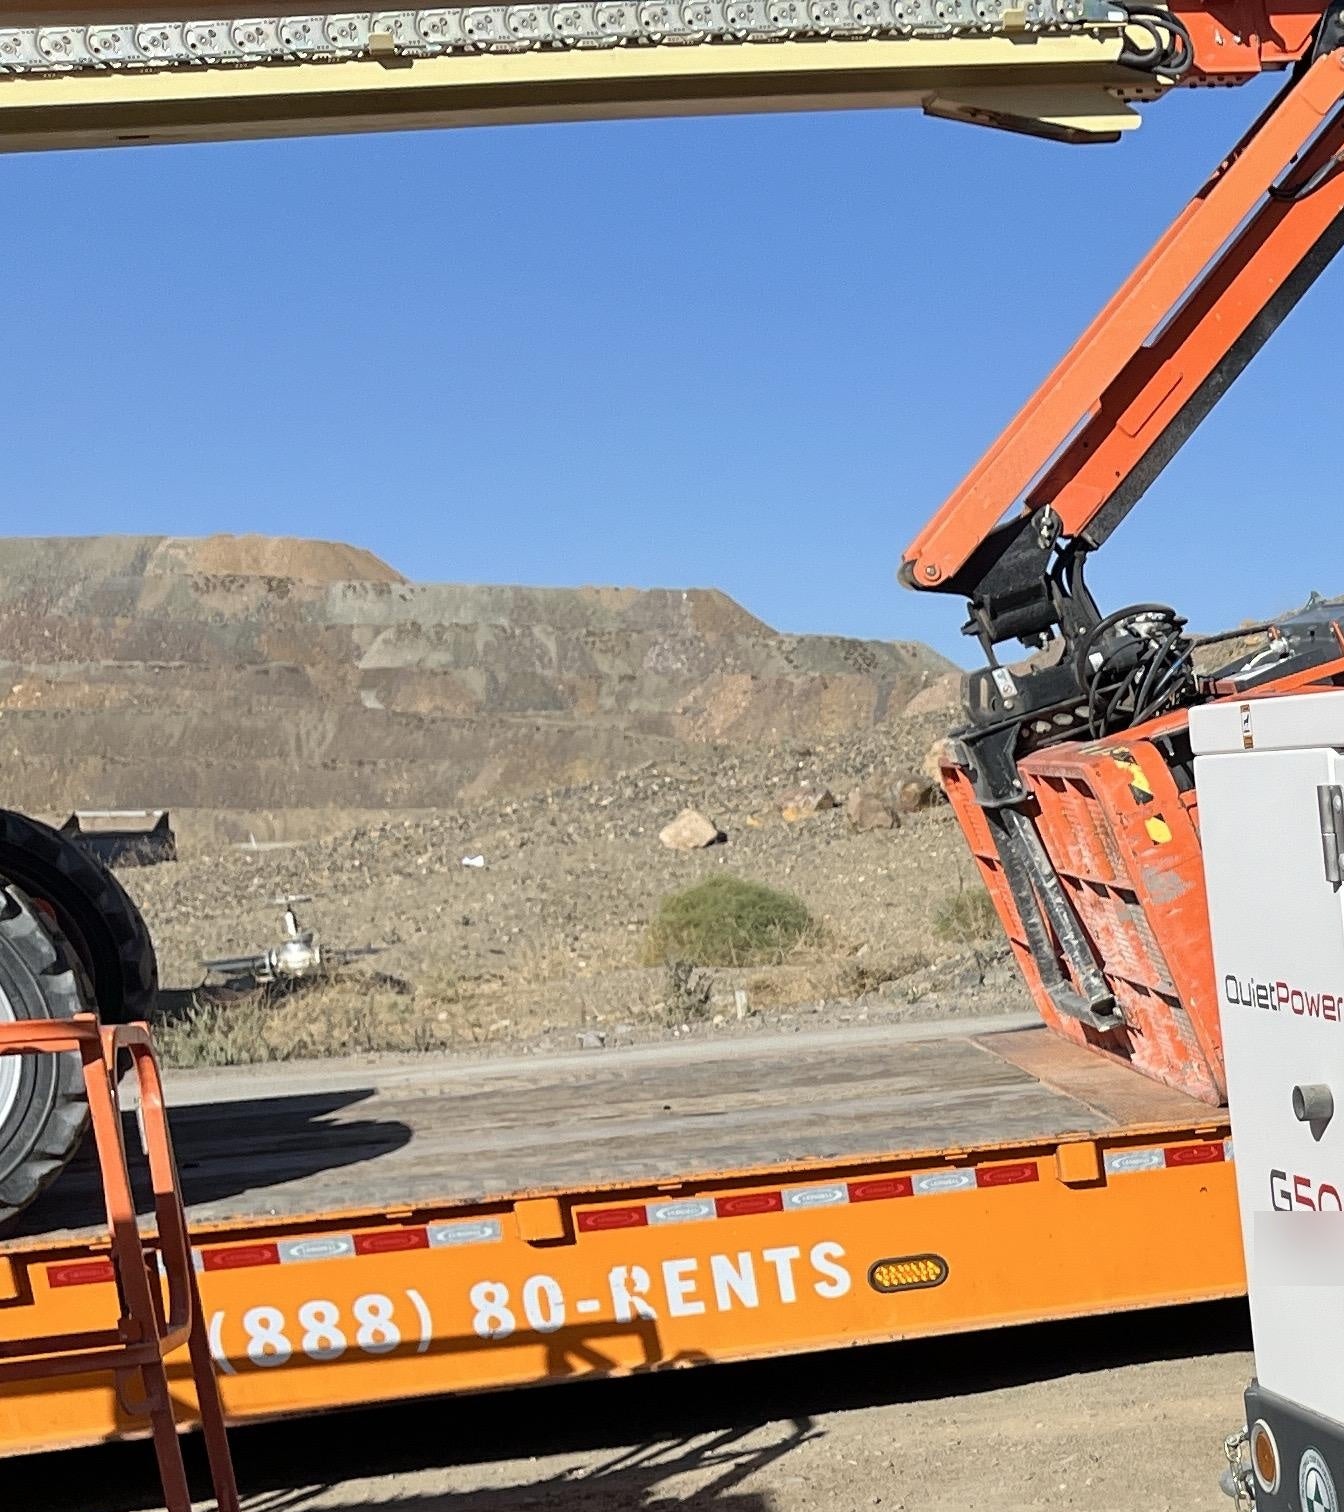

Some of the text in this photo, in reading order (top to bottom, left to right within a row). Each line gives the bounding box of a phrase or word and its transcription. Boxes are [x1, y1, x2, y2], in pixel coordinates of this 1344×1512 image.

[1224, 974, 1344, 1023] QuietPower
[207, 1240, 852, 1376] (888) 80-RENTS
